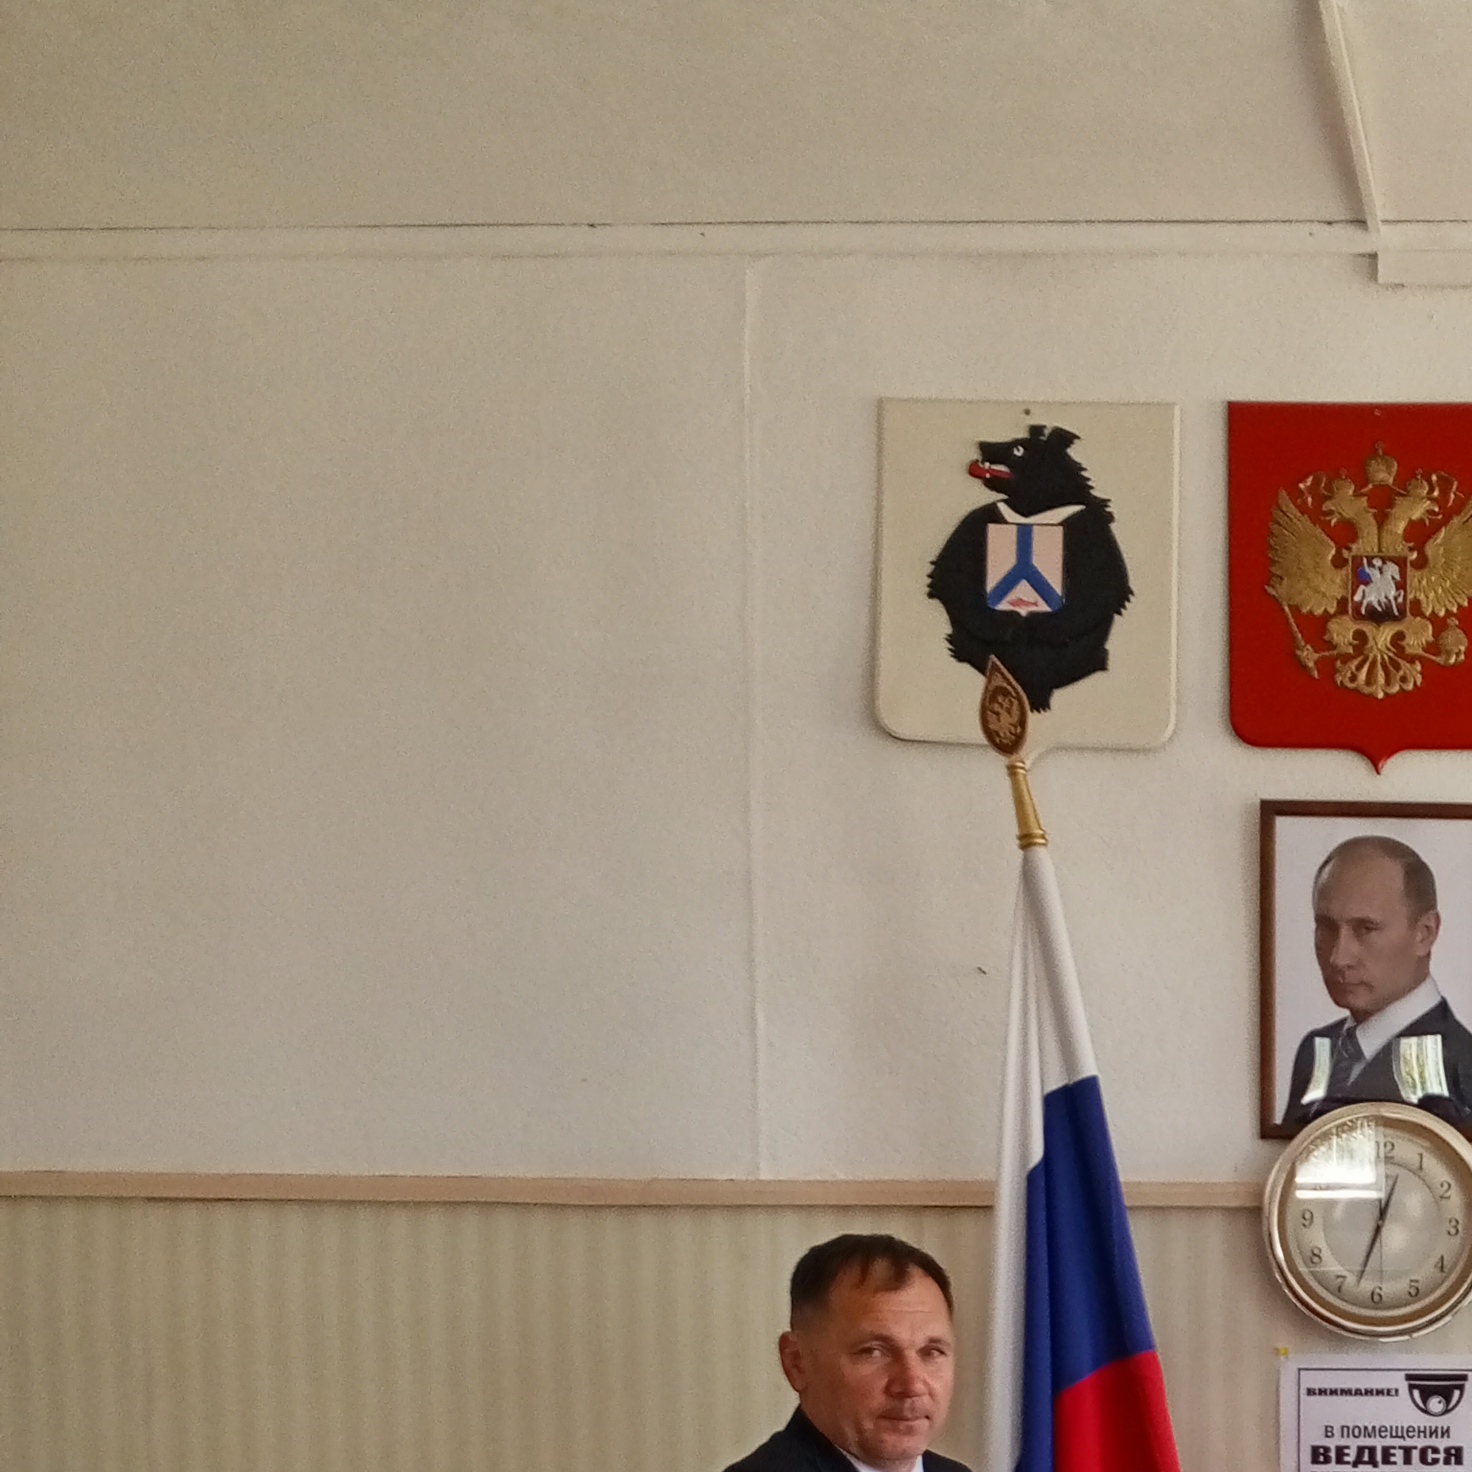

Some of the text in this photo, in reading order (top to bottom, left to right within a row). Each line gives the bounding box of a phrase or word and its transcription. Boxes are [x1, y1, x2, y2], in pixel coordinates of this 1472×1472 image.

[1375, 1141, 1396, 1160] 12
[1416, 1152, 1425, 1170] 1
[1439, 1181, 1452, 1200] 2
[1301, 1210, 1314, 1229] 9
[1446, 1218, 1460, 1237] 3
[1310, 1247, 1323, 1265] 8
[1434, 1254, 1447, 1273] 4
[1335, 1275, 1348, 1293] 7
[1408, 1280, 1421, 1298] 5
[1370, 1286, 1384, 1304] 6
[1306, 1387, 1399, 1397] ВНИМАНИЕ!
[1341, 1425, 1451, 1441] помещении
[1310, 1445, 1464, 1468] ВЕДЕТСЯ
